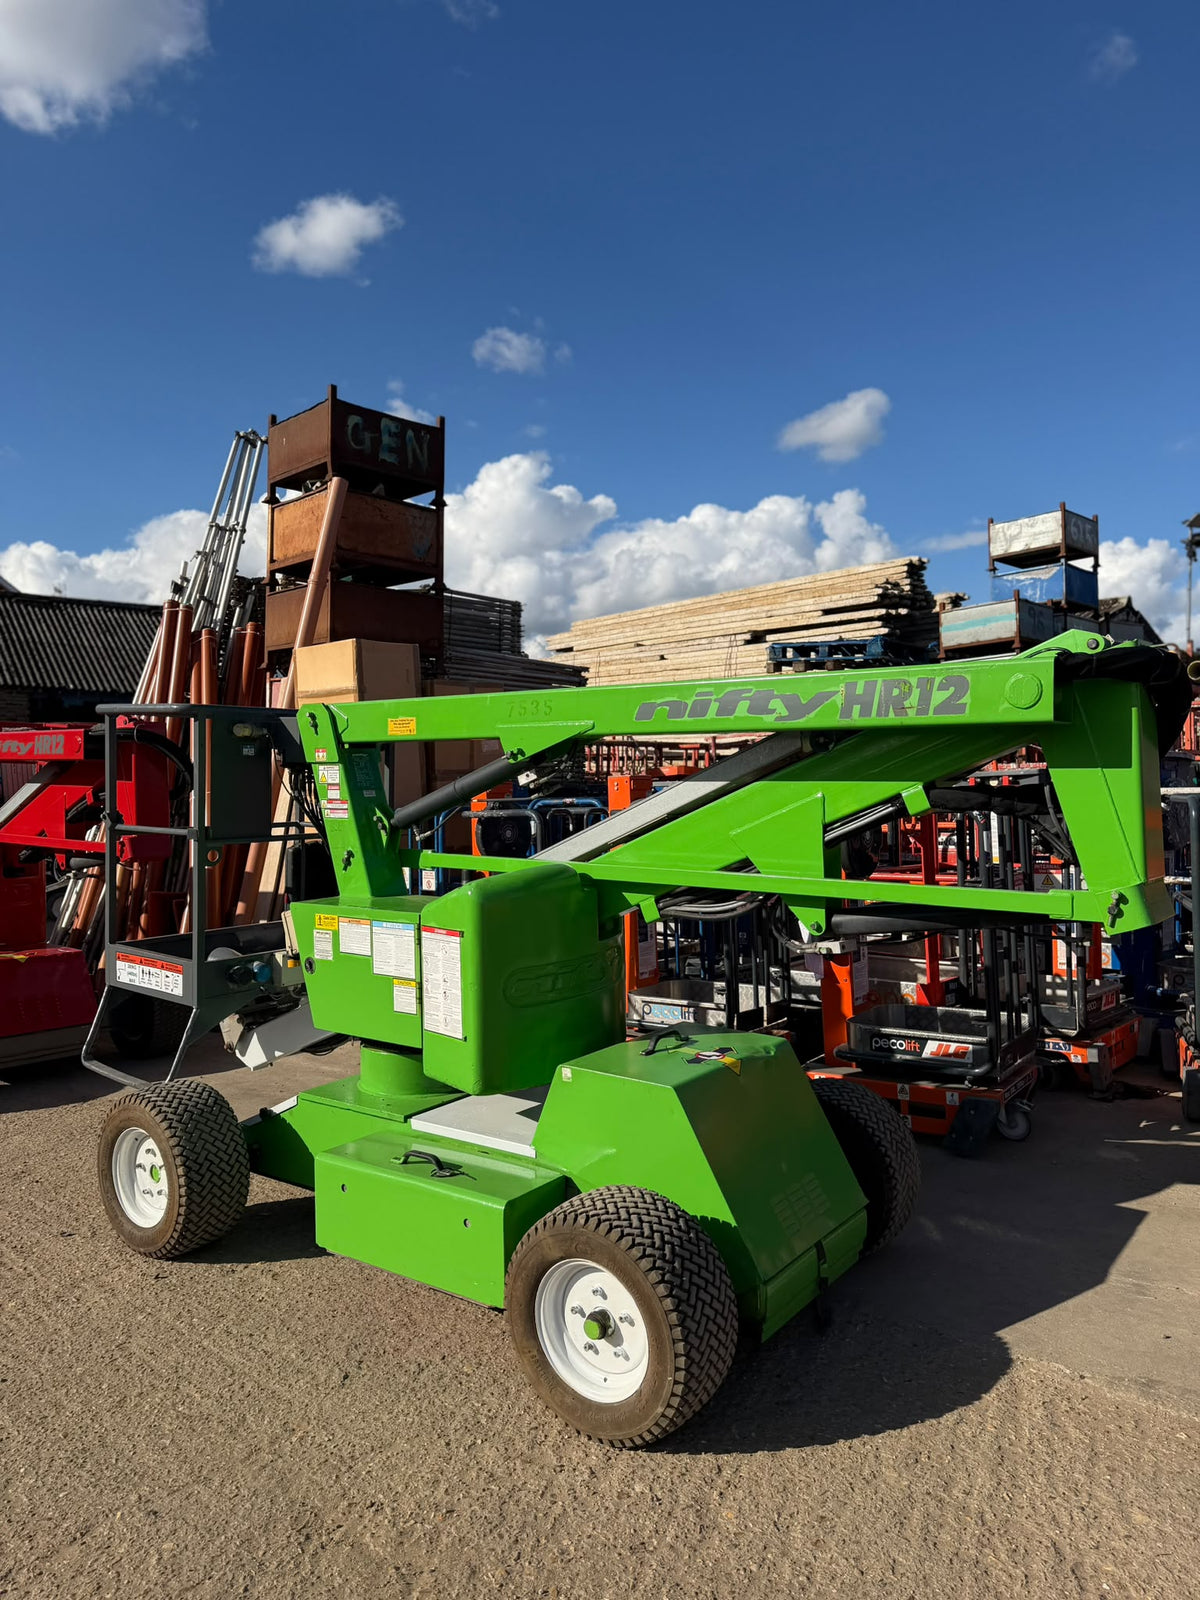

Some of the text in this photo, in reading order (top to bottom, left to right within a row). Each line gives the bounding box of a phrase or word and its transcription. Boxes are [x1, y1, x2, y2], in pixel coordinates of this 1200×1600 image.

[346, 413, 431, 474] GEN
[507, 699, 553, 718] 7535
[634, 674, 970, 723] nifty HR12
[0, 734, 65, 756] fty HR12
[871, 1037, 971, 1060] pecolift JLG
